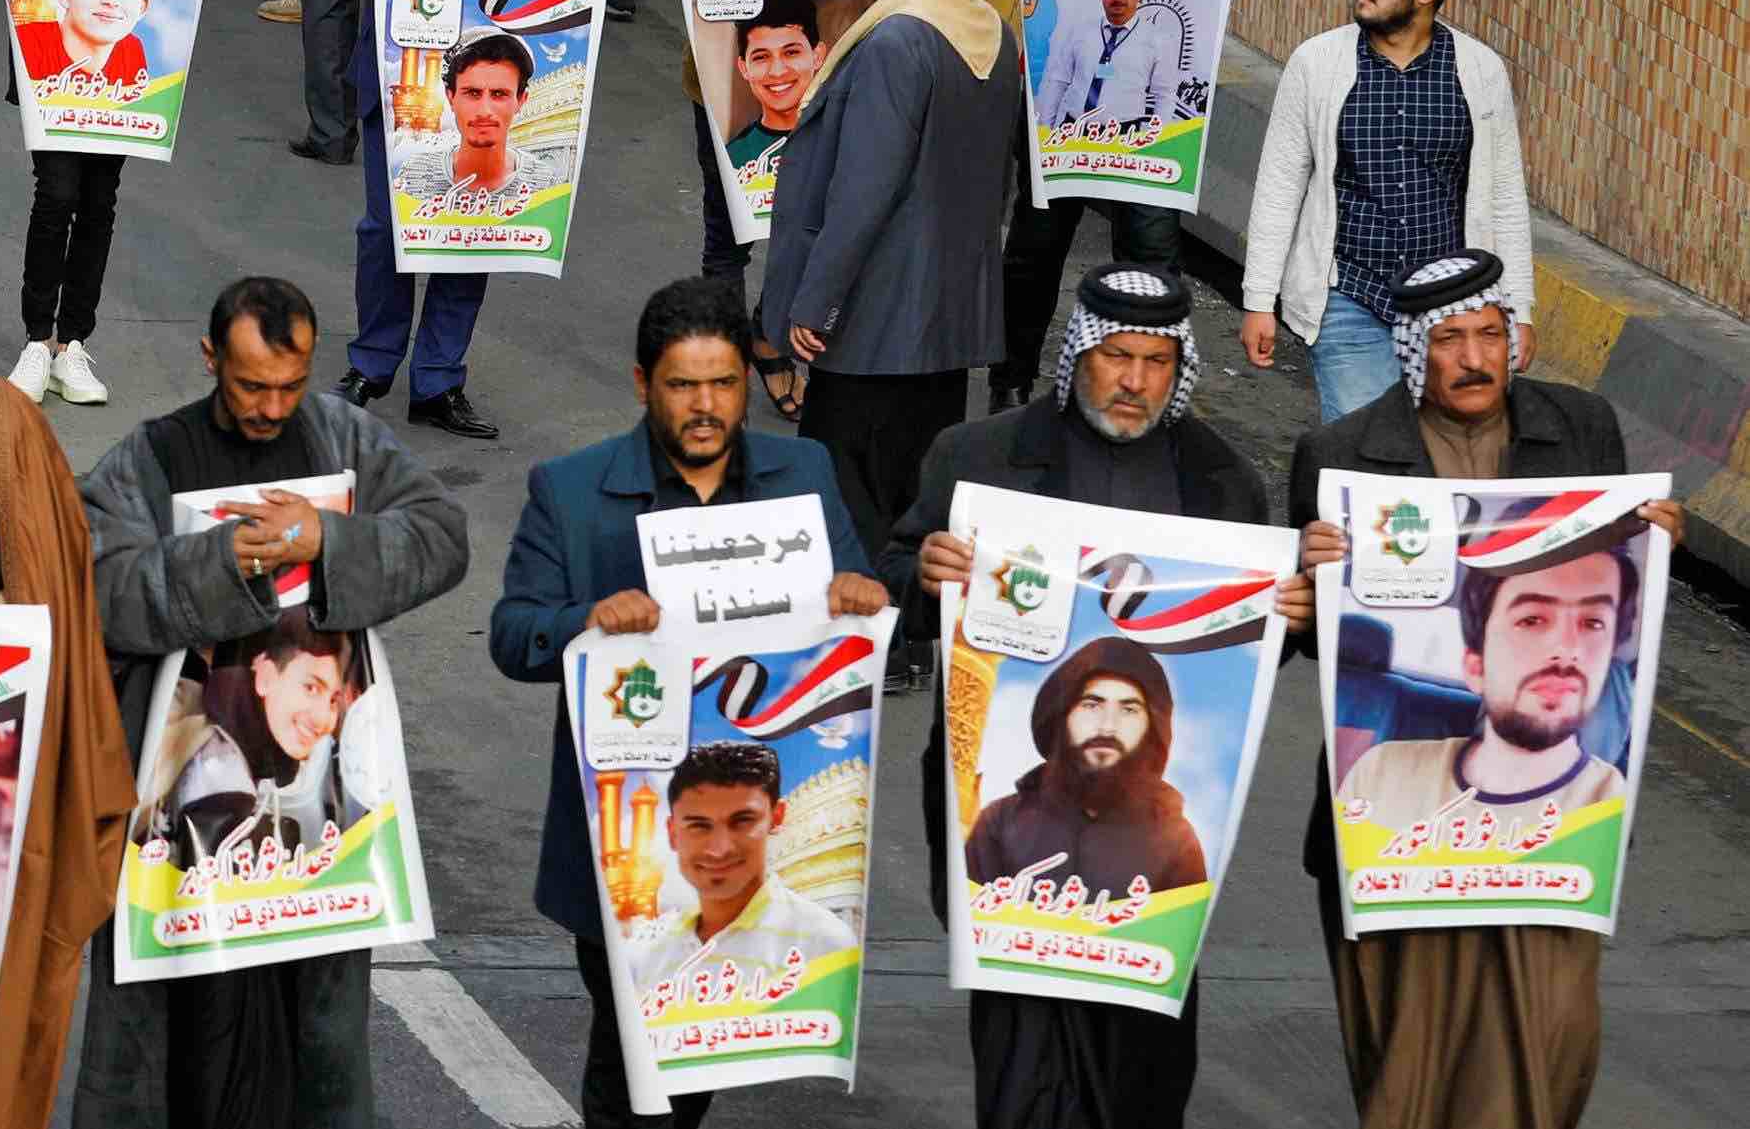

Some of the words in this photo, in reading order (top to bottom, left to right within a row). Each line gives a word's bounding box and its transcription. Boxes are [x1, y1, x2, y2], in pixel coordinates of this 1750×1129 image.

[652, 528, 812, 570] مرجعيتنا
[695, 588, 792, 624] سندنا
[1355, 870, 1409, 895] الاعلام
[1422, 870, 1453, 893] قار
[1457, 872, 1478, 897] ذي
[1485, 865, 1531, 889] اغاثة
[1535, 869, 1579, 894] وحدة
[227, 904, 253, 931] قار
[255, 899, 276, 930] ذي
[280, 895, 324, 919] اغاثة
[327, 894, 371, 915] وحدة
[164, 911, 208, 941] الاعلام
[1002, 931, 1035, 953] قار
[1037, 933, 1059, 961] ذي
[1065, 935, 1115, 962] اغاثة
[1117, 947, 1163, 977] وحدة
[673, 1025, 702, 1053] قار
[708, 1021, 730, 1051] ذي
[733, 1017, 780, 1040] اغاثة
[782, 1017, 830, 1041] وحدة
